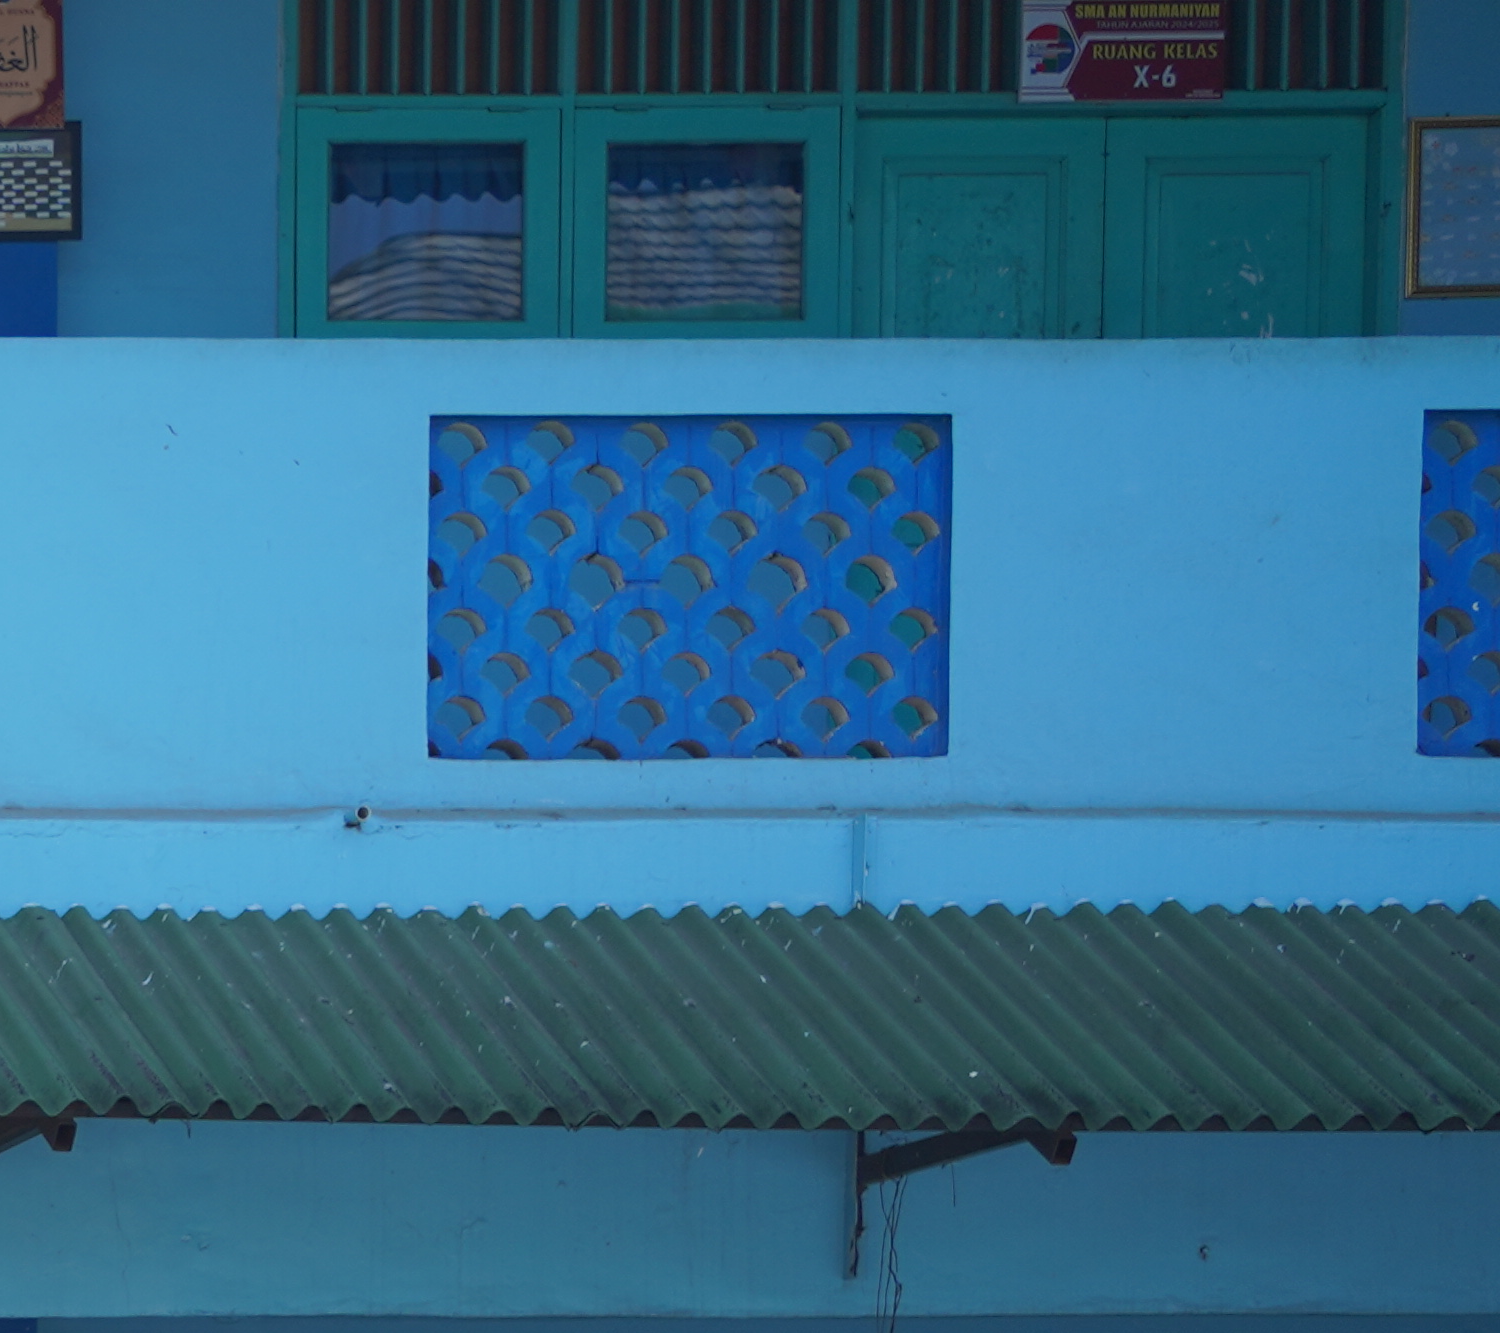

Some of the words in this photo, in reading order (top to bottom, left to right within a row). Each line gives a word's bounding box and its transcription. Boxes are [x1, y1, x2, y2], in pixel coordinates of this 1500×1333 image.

[1075, 3, 1105, 18] SMA
[1108, 3, 1126, 18] AN
[1130, 3, 1220, 18] NURMANIYAH
[1092, 43, 1156, 59] RUANG
[1163, 43, 1218, 59] KELAS
[1133, 65, 1176, 88] X-6
